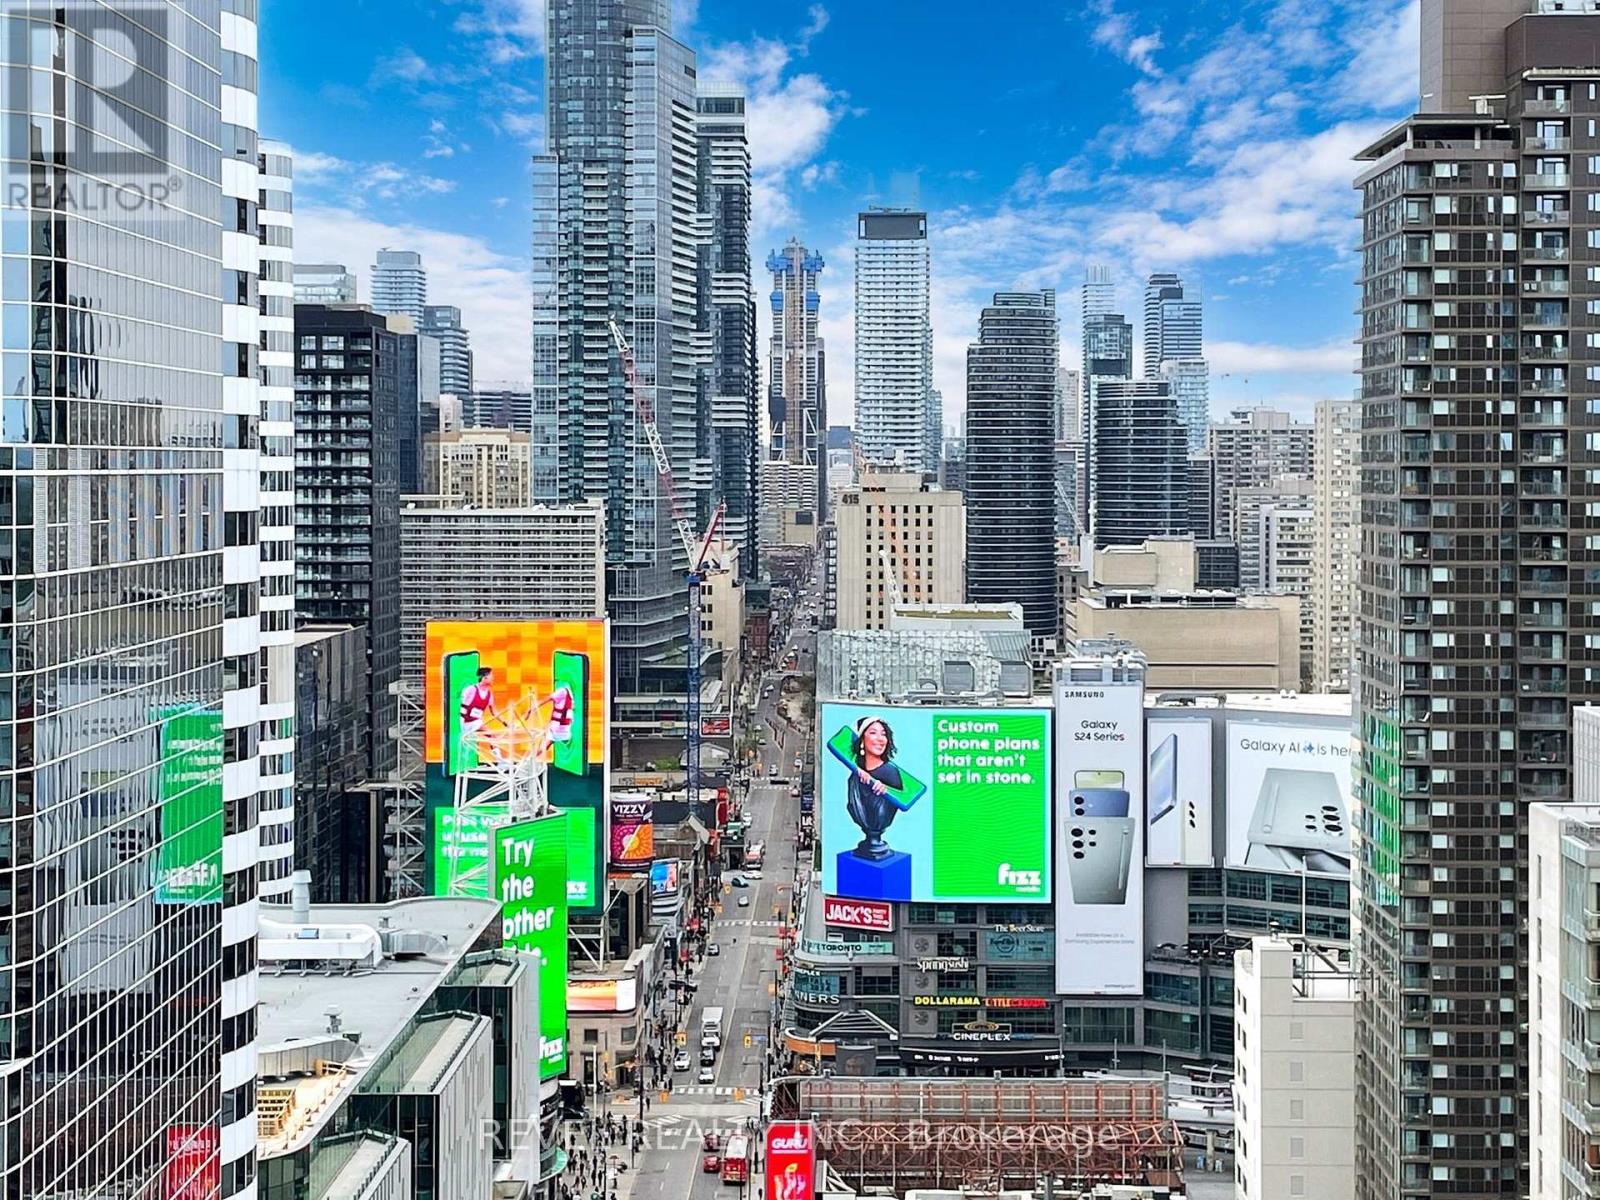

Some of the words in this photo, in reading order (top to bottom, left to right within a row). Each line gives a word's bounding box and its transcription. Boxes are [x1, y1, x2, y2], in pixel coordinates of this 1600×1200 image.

[842, 493, 860, 505] 415
[1064, 691, 1105, 699] SAMSUNG
[937, 719, 1000, 734] Custom
[1080, 720, 1119, 731] Galaxy
[1074, 732, 1092, 741] S24
[1094, 732, 1125, 741] Series
[937, 736, 990, 753] phone
[994, 736, 1040, 753] plans
[1240, 738, 1286, 756] Galaxy
[1288, 741, 1301, 753] AI
[1316, 744, 1328, 756] is
[937, 753, 972, 767] that
[975, 753, 1026, 767] aren't
[937, 771, 962, 784] set
[966, 769, 981, 784] in
[985, 771, 1036, 784] stone.
[612, 804, 647, 815] VIZZY
[502, 837, 535, 868] Try
[998, 863, 1041, 885] fizz
[501, 873, 535, 904] the
[825, 903, 873, 925] JACK'S
[502, 906, 555, 941] other
[822, 944, 862, 952] TORONTO
[914, 996, 981, 1006] DOLLARAMA
[952, 1032, 1012, 1042] CINEPLEX
